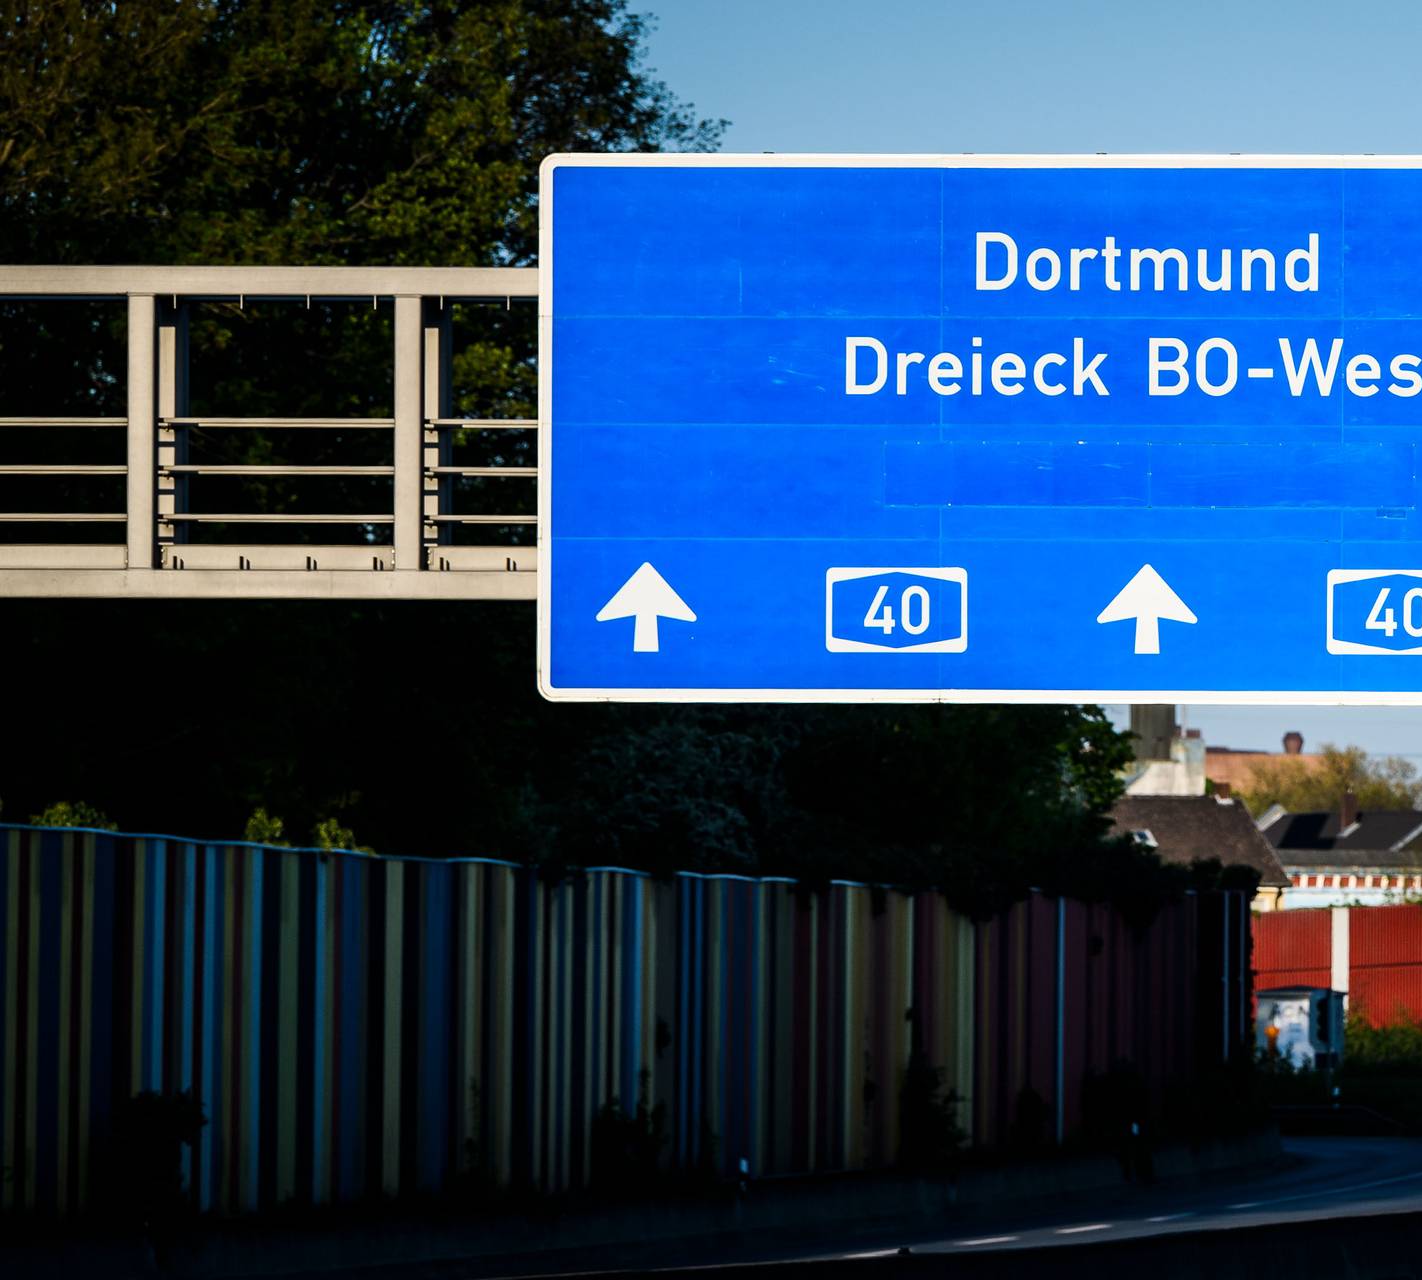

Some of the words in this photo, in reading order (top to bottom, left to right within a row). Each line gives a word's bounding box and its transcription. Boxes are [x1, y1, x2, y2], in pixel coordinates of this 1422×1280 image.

[975, 231, 1319, 292] Dortmund
[845, 336, 1110, 396] Dreieck
[863, 585, 930, 635] 40
